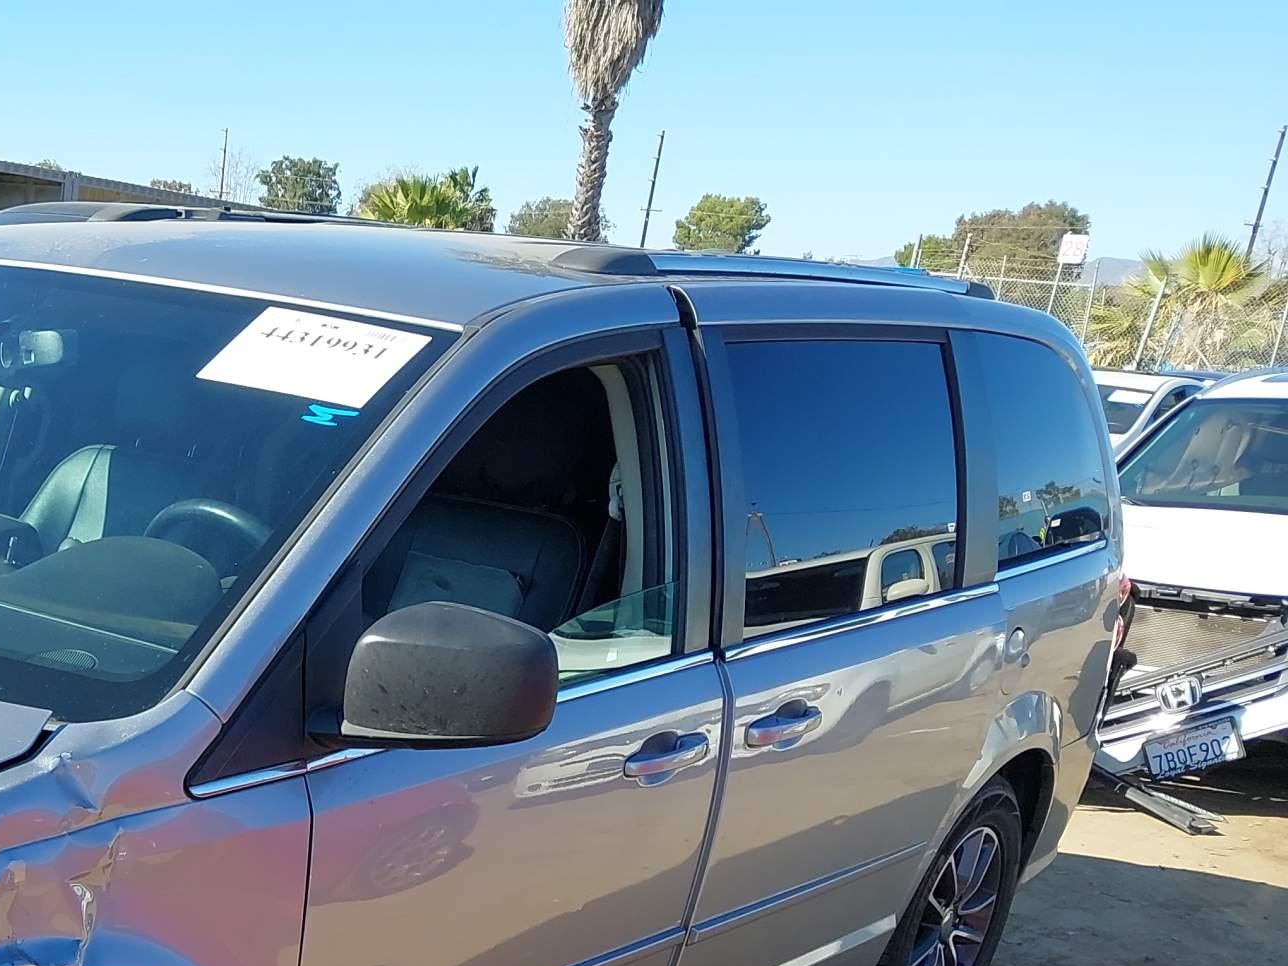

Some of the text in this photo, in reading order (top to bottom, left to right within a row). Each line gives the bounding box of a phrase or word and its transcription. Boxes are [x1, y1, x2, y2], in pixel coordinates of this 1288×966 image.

[1062, 240, 1085, 257] 28
[260, 326, 388, 360] 44319931
[1162, 730, 1217, 750] California
